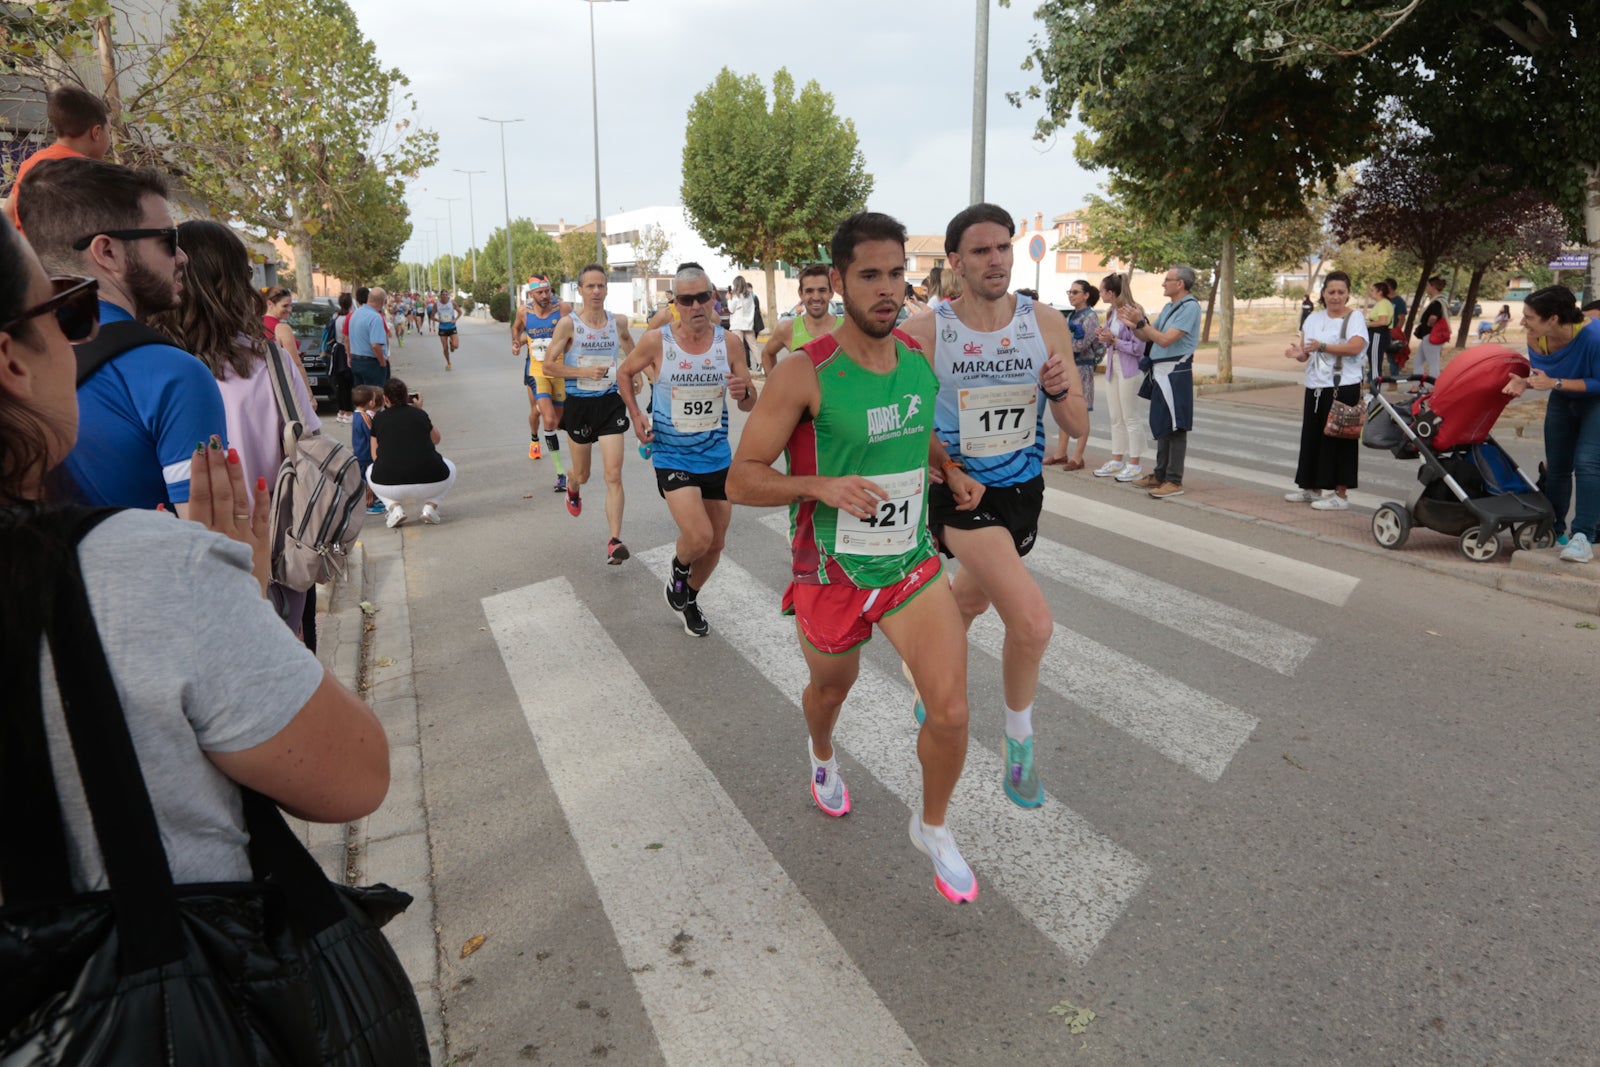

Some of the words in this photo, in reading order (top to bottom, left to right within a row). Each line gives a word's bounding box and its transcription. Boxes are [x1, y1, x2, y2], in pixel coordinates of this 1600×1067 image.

[952, 358, 1033, 374] MARACENA
[671, 373, 723, 382] MARACENA
[683, 401, 713, 415] 592
[867, 403, 901, 436] ATARFE
[979, 408, 1025, 432] 177
[868, 430, 901, 445] Atletismo
[903, 424, 924, 436] Atarfe
